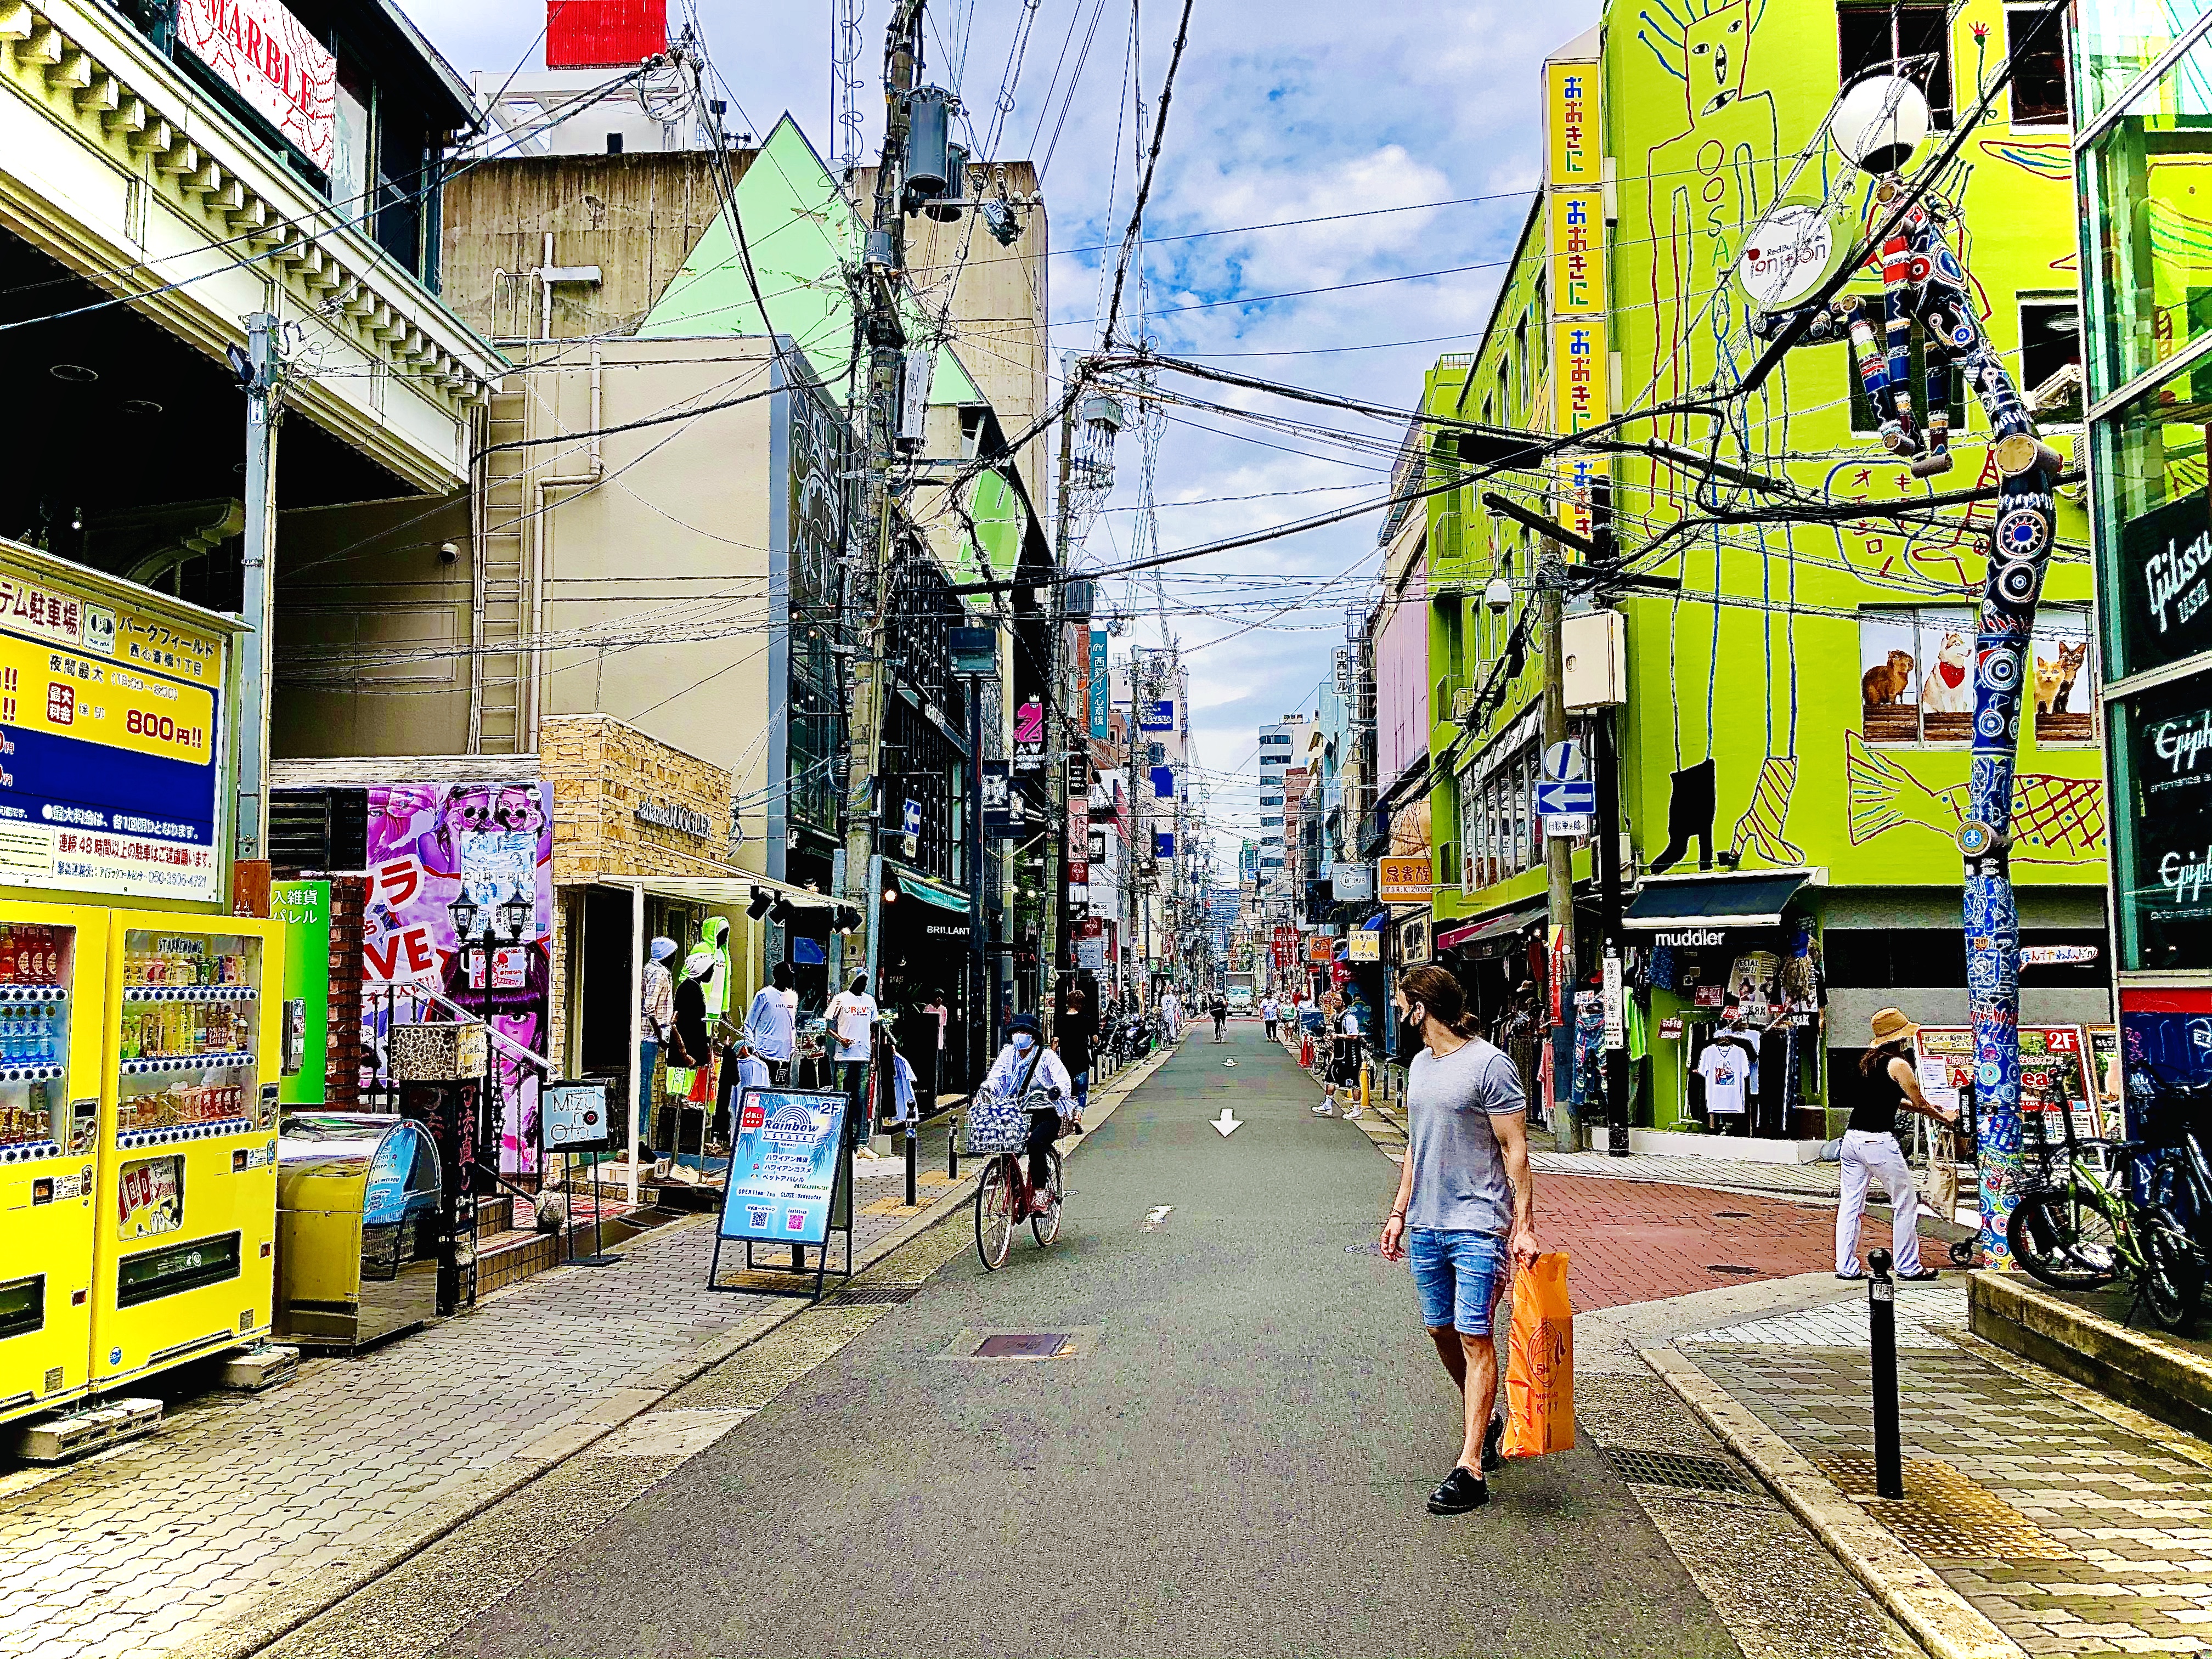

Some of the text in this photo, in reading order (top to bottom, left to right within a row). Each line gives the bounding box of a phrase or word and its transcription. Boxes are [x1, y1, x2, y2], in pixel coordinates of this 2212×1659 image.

[205, 0, 317, 122] MARBLE
[1565, 77, 1583, 172] おおきに
[1567, 201, 1588, 306] おおきに
[1570, 329, 1590, 435] おおきに
[1573, 462, 1593, 566] おおき
[119, 616, 215, 659] パークフィールド
[49, 654, 105, 684] 夜間最大
[49, 686, 72, 704] 最大
[1094, 657, 1105, 725] 西鉄イン心斎橋
[48, 703, 72, 723] 料金
[1549, 820, 1586, 831] 自転車を除く
[1386, 866, 1430, 882] 鳥貴族
[272, 889, 318, 906] 入雑貨
[1655, 929, 1725, 946] muddler
[2049, 1032, 2074, 1049] 2F
[820, 1102, 840, 1115] 2F
[764, 1119, 819, 1132] Rainbow
